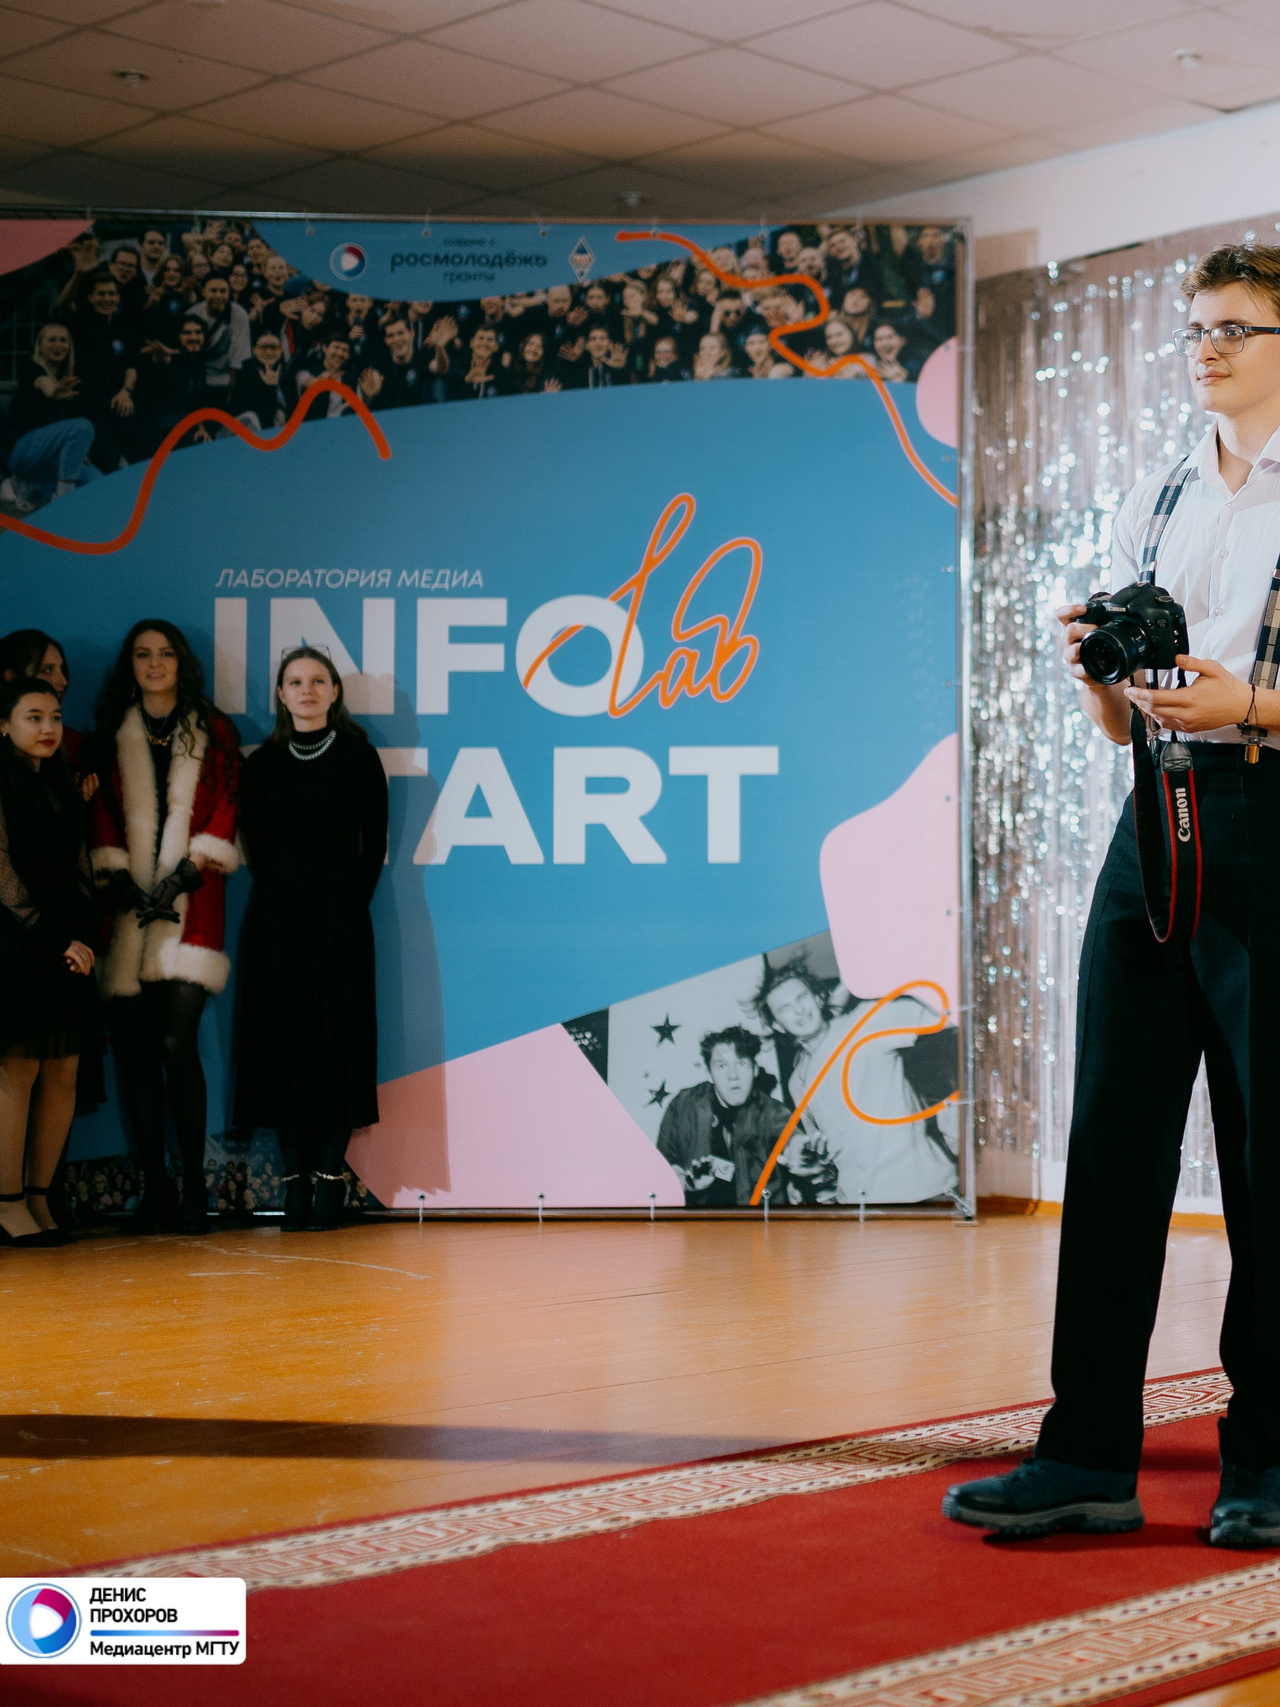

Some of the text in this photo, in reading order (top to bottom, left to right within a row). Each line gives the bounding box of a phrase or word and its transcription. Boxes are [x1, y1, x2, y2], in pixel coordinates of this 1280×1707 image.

[390, 250, 548, 273] росмолодёжь
[215, 568, 484, 591] ЛАБОРАТОРИЯ МЕДИА
[214, 594, 644, 717] INFO
[240, 745, 779, 865] ART
[1177, 787, 1191, 842] Canon
